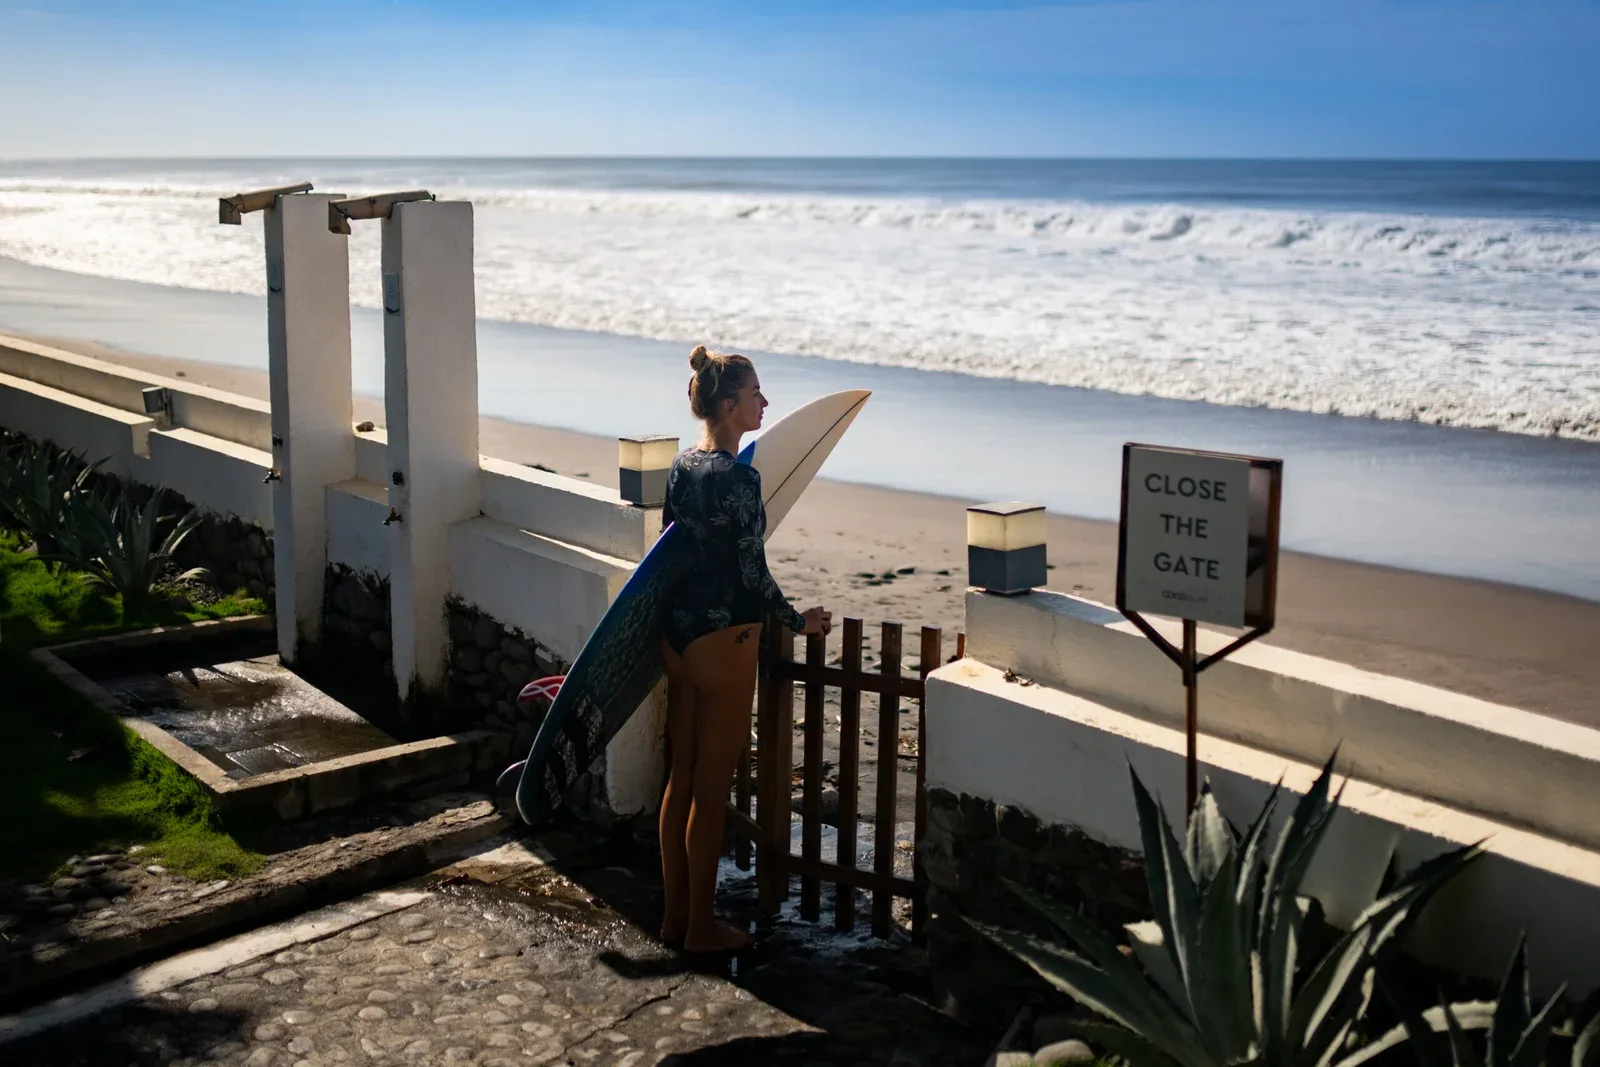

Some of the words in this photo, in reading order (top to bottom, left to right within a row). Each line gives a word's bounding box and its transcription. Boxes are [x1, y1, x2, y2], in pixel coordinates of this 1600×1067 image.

[1144, 473, 1227, 502] CLOSE
[1160, 513, 1209, 539] THE
[1153, 551, 1220, 580] GATE
